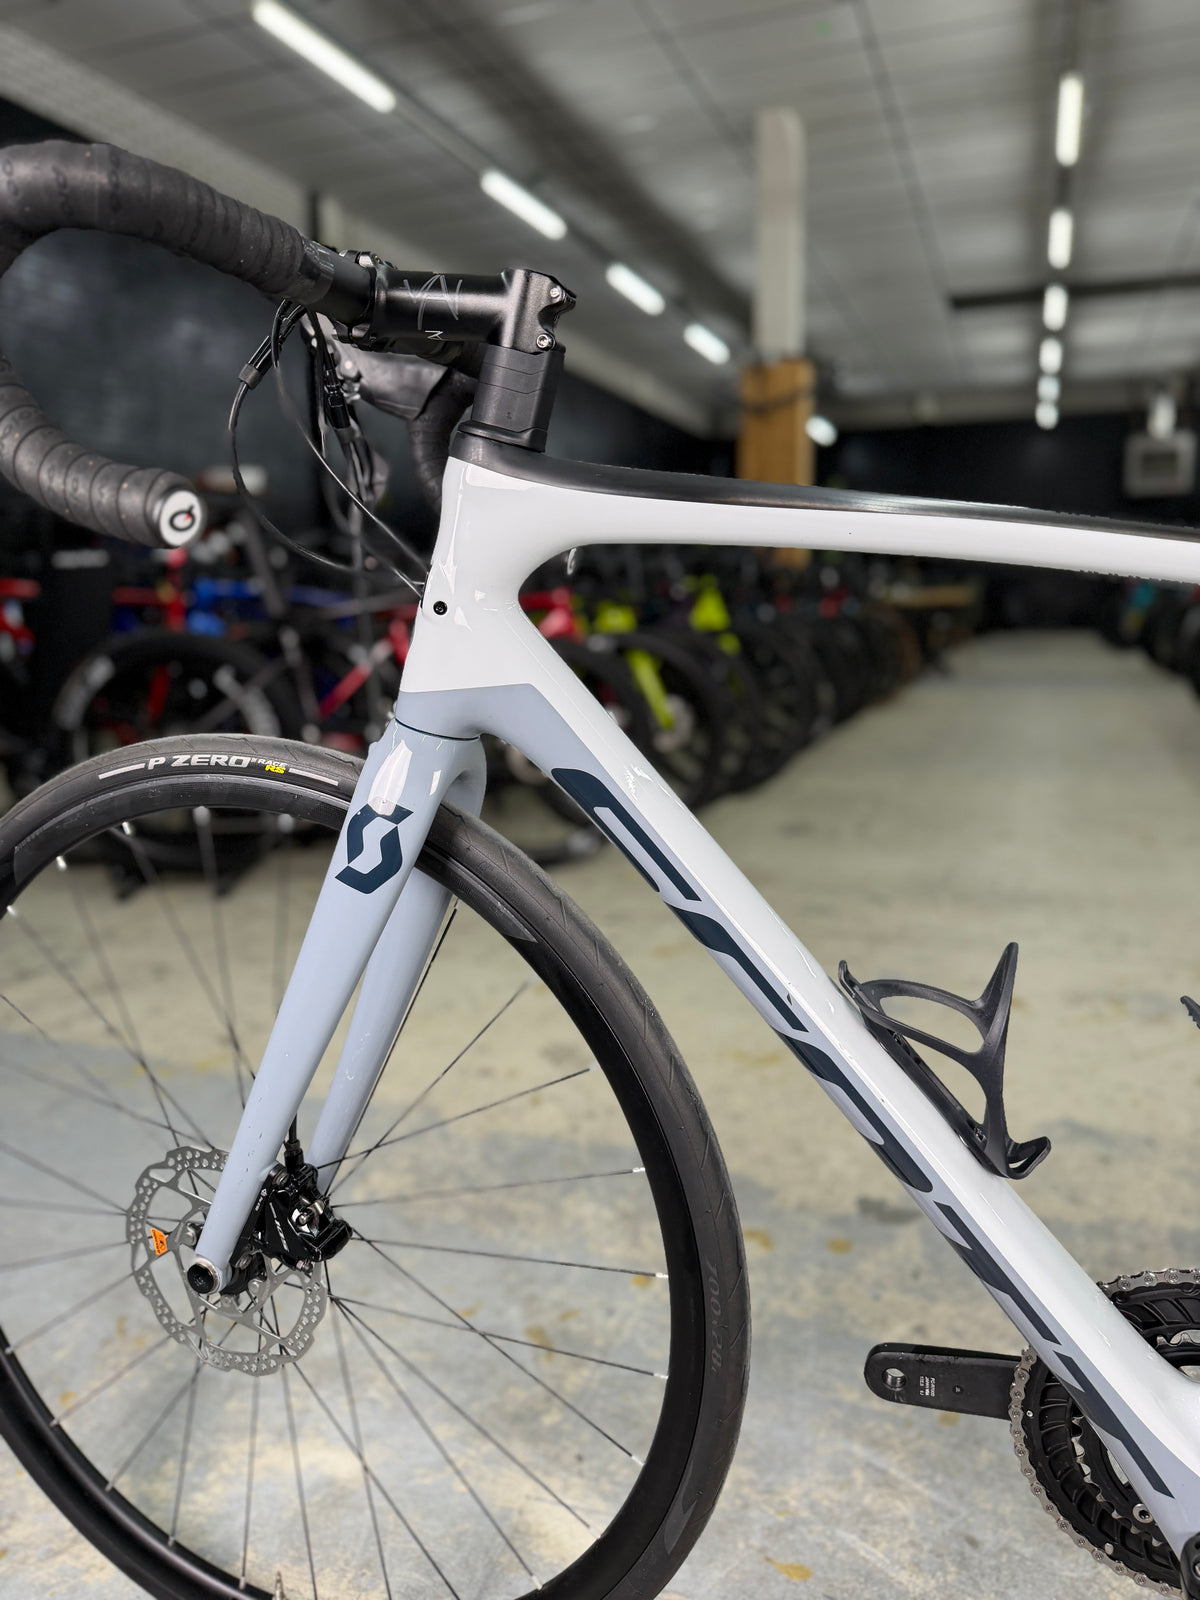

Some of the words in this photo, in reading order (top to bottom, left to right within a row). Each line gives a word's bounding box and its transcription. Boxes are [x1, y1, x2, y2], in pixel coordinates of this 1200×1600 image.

[147, 756, 166, 770] P
[170, 754, 251, 768] ZERO
[264, 764, 286, 774] RS
